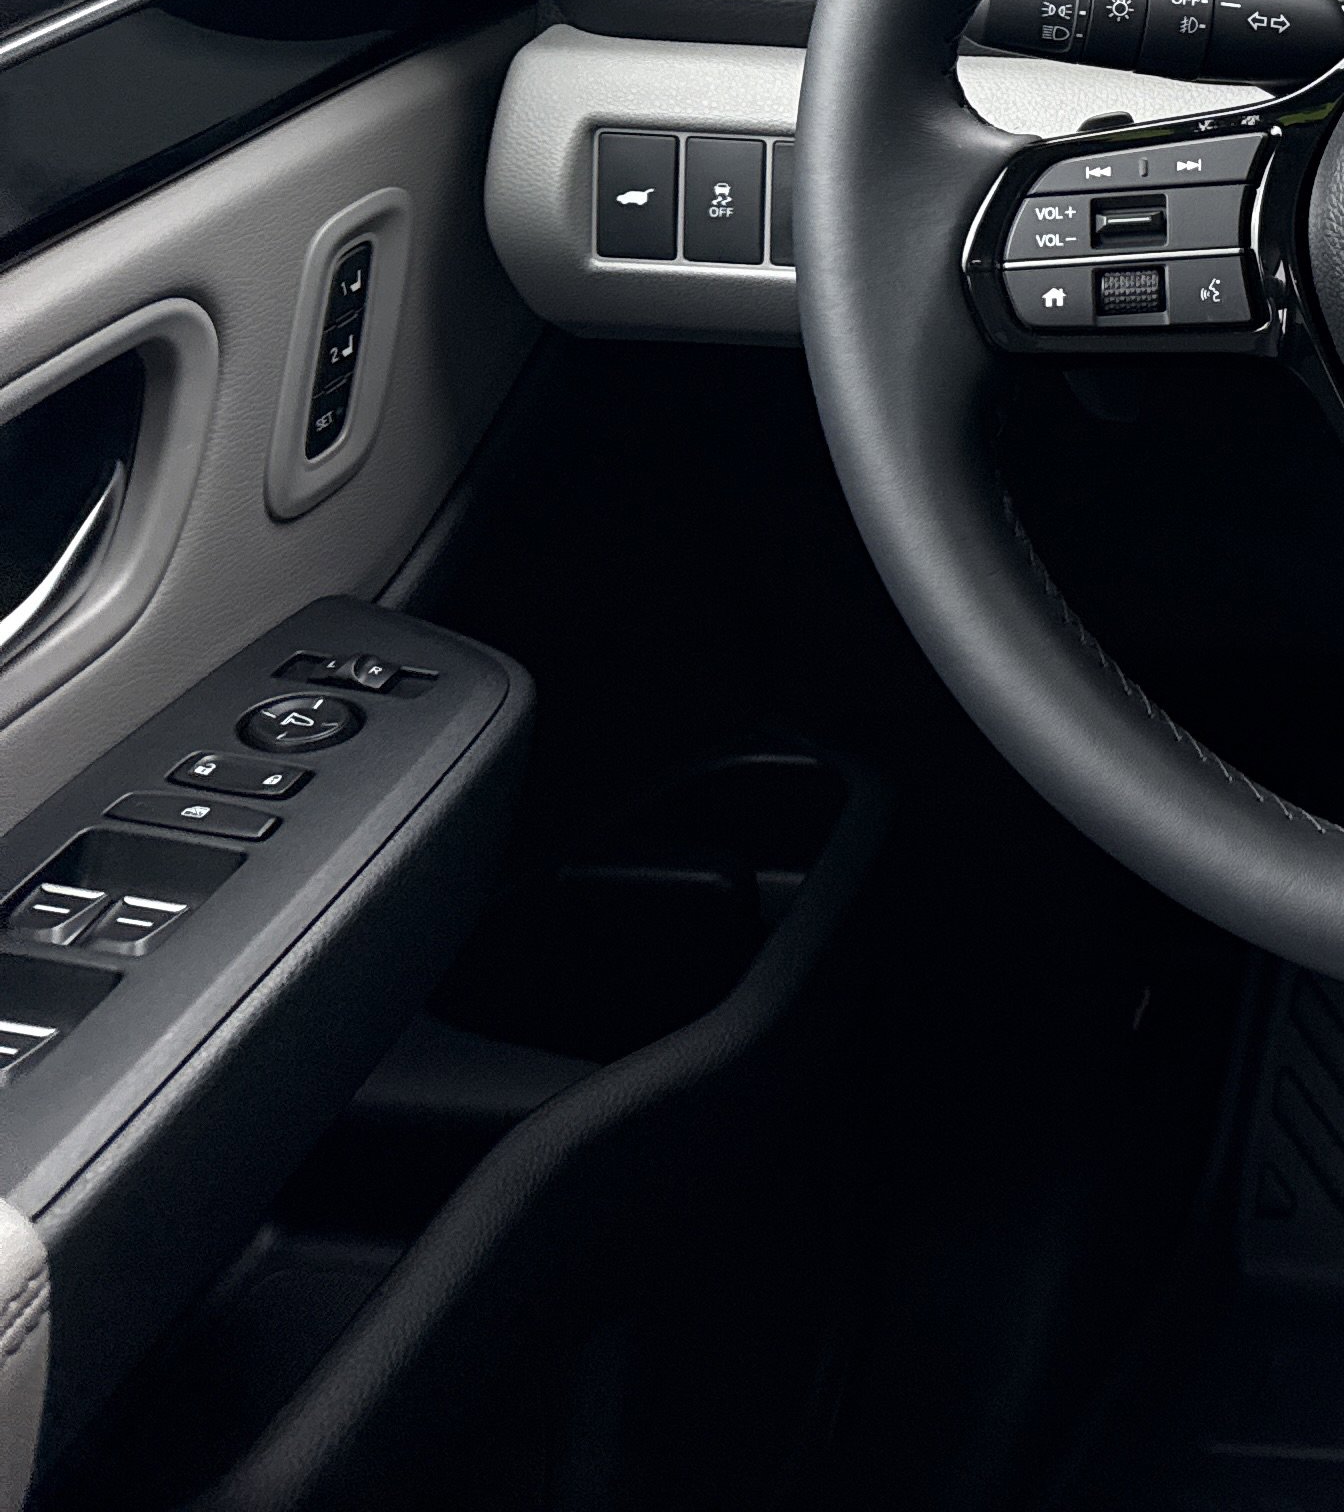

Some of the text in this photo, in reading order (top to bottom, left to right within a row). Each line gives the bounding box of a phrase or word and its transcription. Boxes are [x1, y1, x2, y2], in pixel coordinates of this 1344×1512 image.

[709, 207, 734, 218] OFF
[341, 281, 348, 296] 1
[329, 347, 339, 364] 2
[315, 410, 335, 432] SET
[367, 666, 382, 675] R
